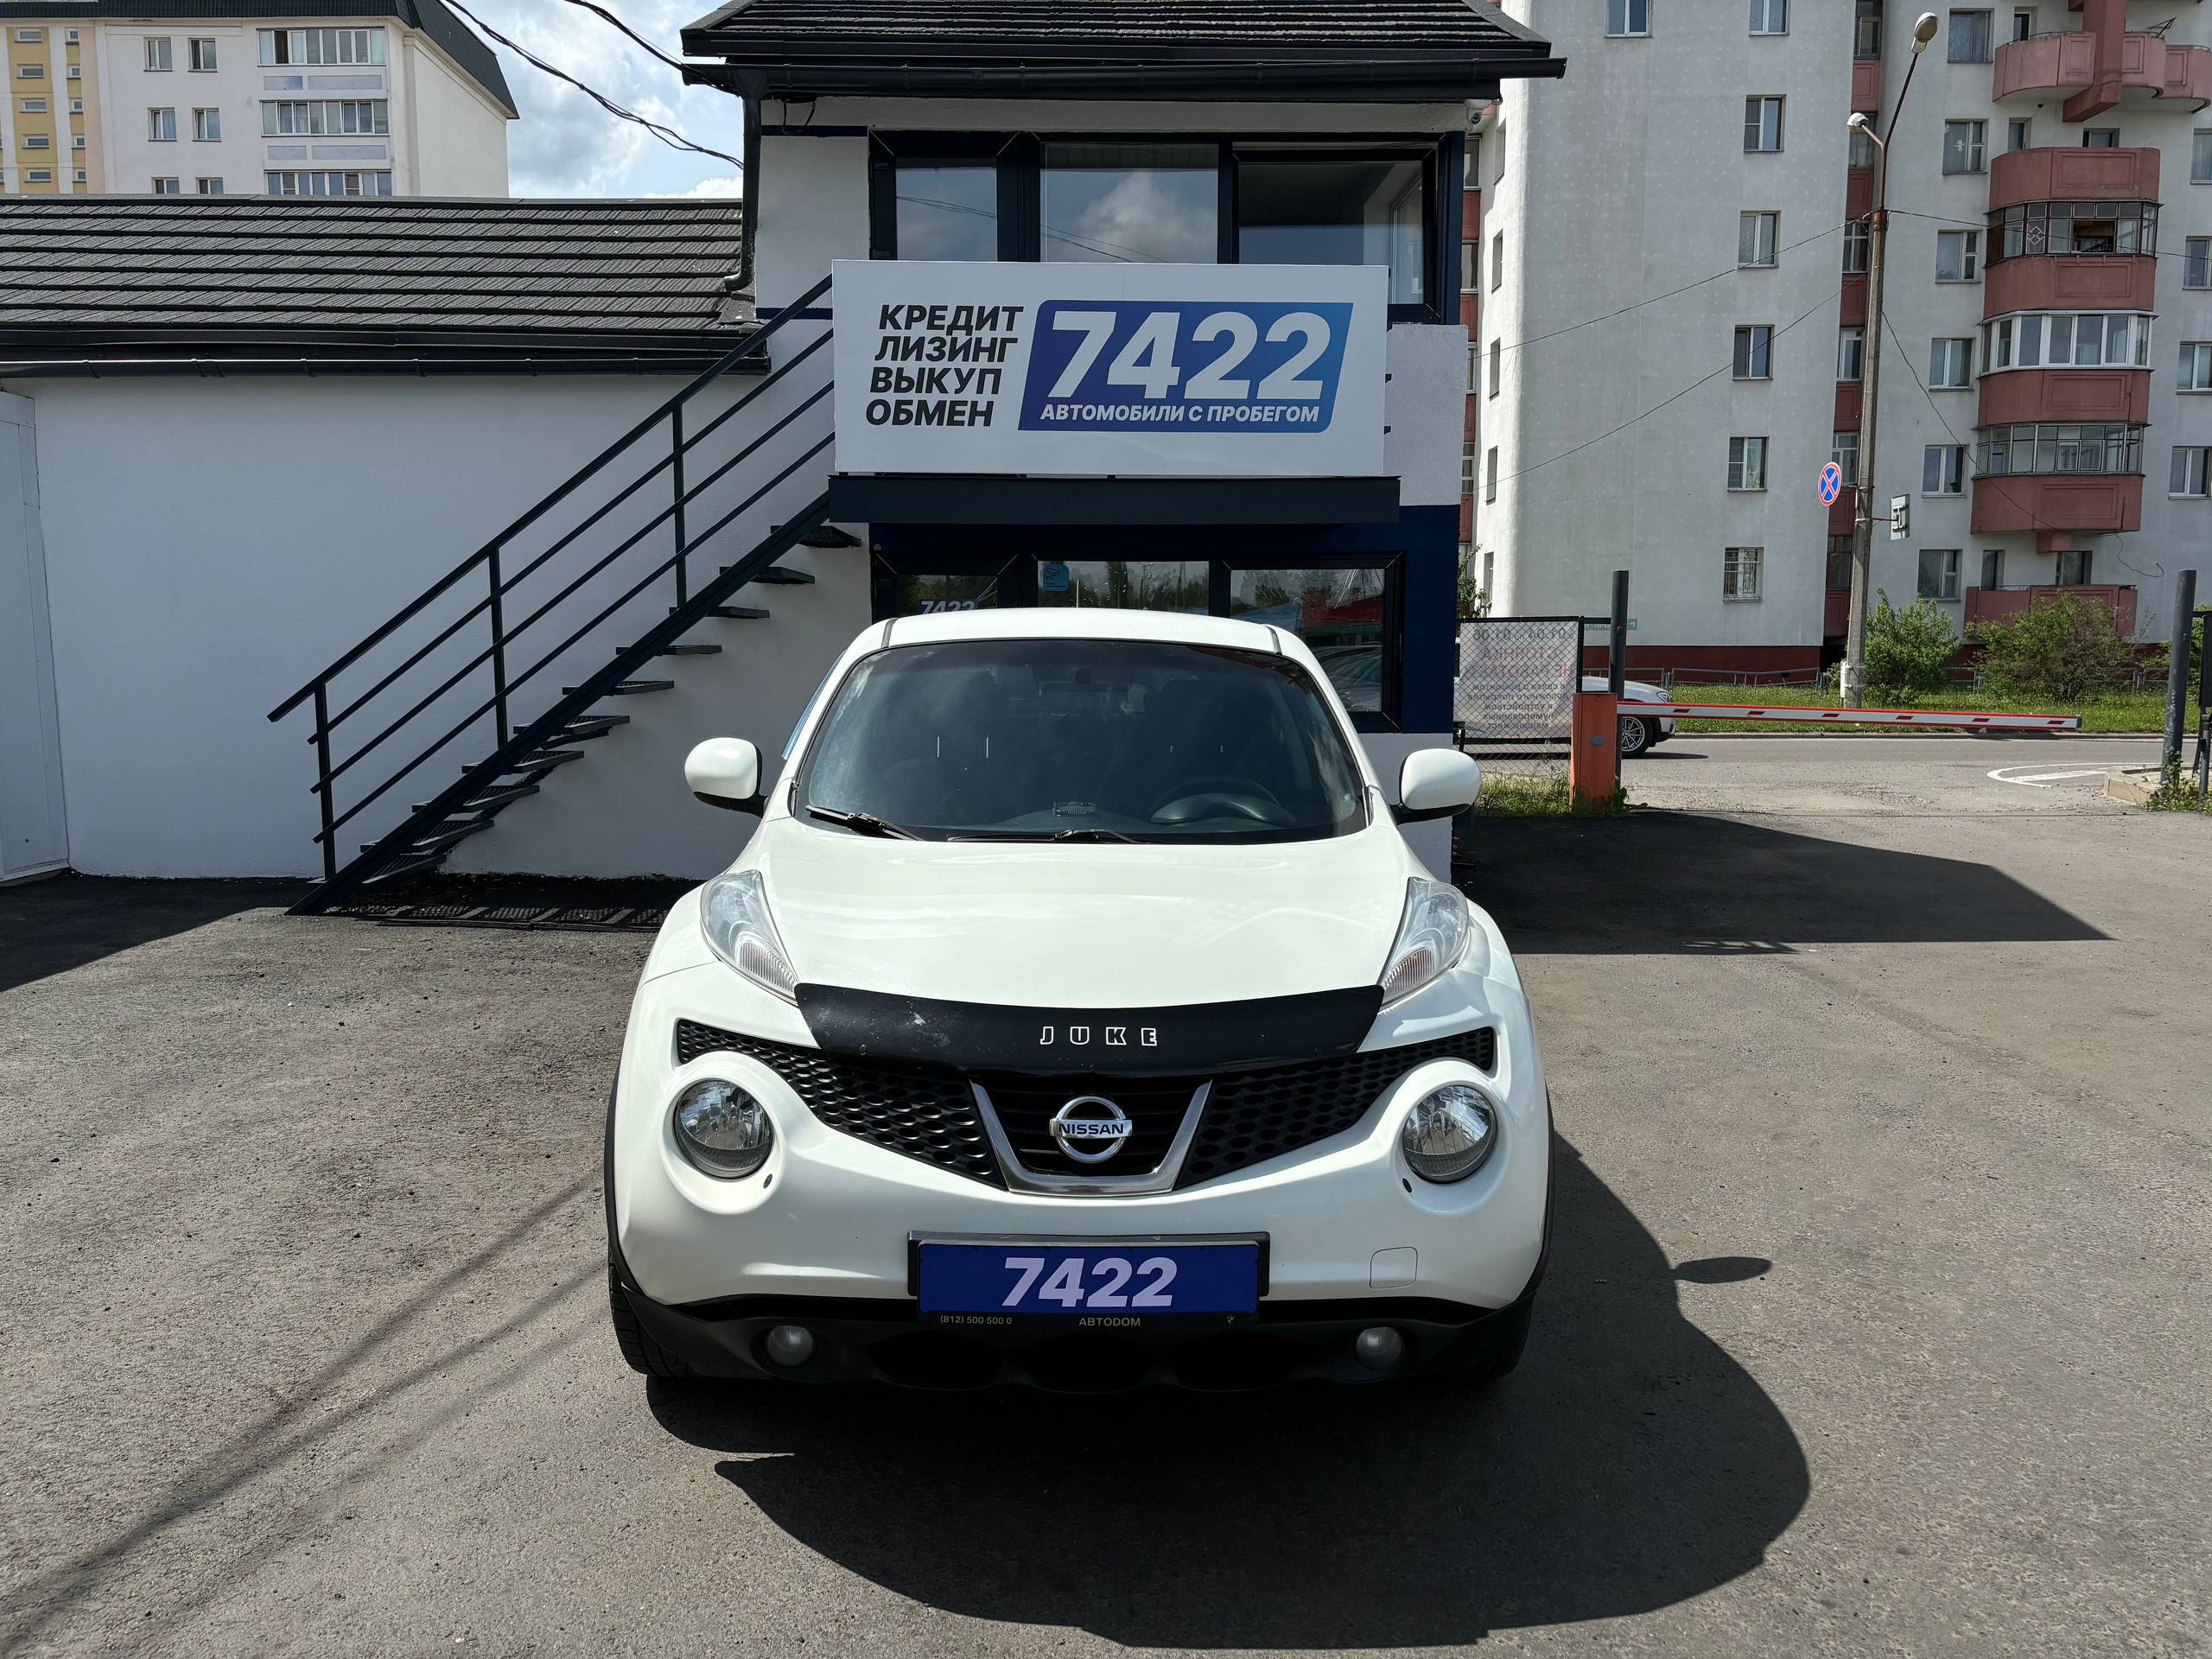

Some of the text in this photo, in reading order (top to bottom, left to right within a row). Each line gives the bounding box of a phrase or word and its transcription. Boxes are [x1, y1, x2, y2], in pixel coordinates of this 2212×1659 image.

[879, 304, 1024, 334] КРЕДИТ
[874, 335, 1018, 363] ЛИЗИНГ
[1047, 311, 1332, 400] 7422
[869, 367, 1001, 394] ВЫКУП
[865, 398, 994, 427] ОБМЕН
[1039, 404, 1319, 423] АВТОМОБИЛИ С ПРОБЕГОМ
[1039, 1026, 1158, 1046] JUKE
[1058, 1123, 1124, 1135] NISSAN
[1001, 1256, 1178, 1307] 7422
[940, 1314, 964, 1325] (812)
[966, 1316, 984, 1325] 500
[986, 1316, 1004, 1325] 500
